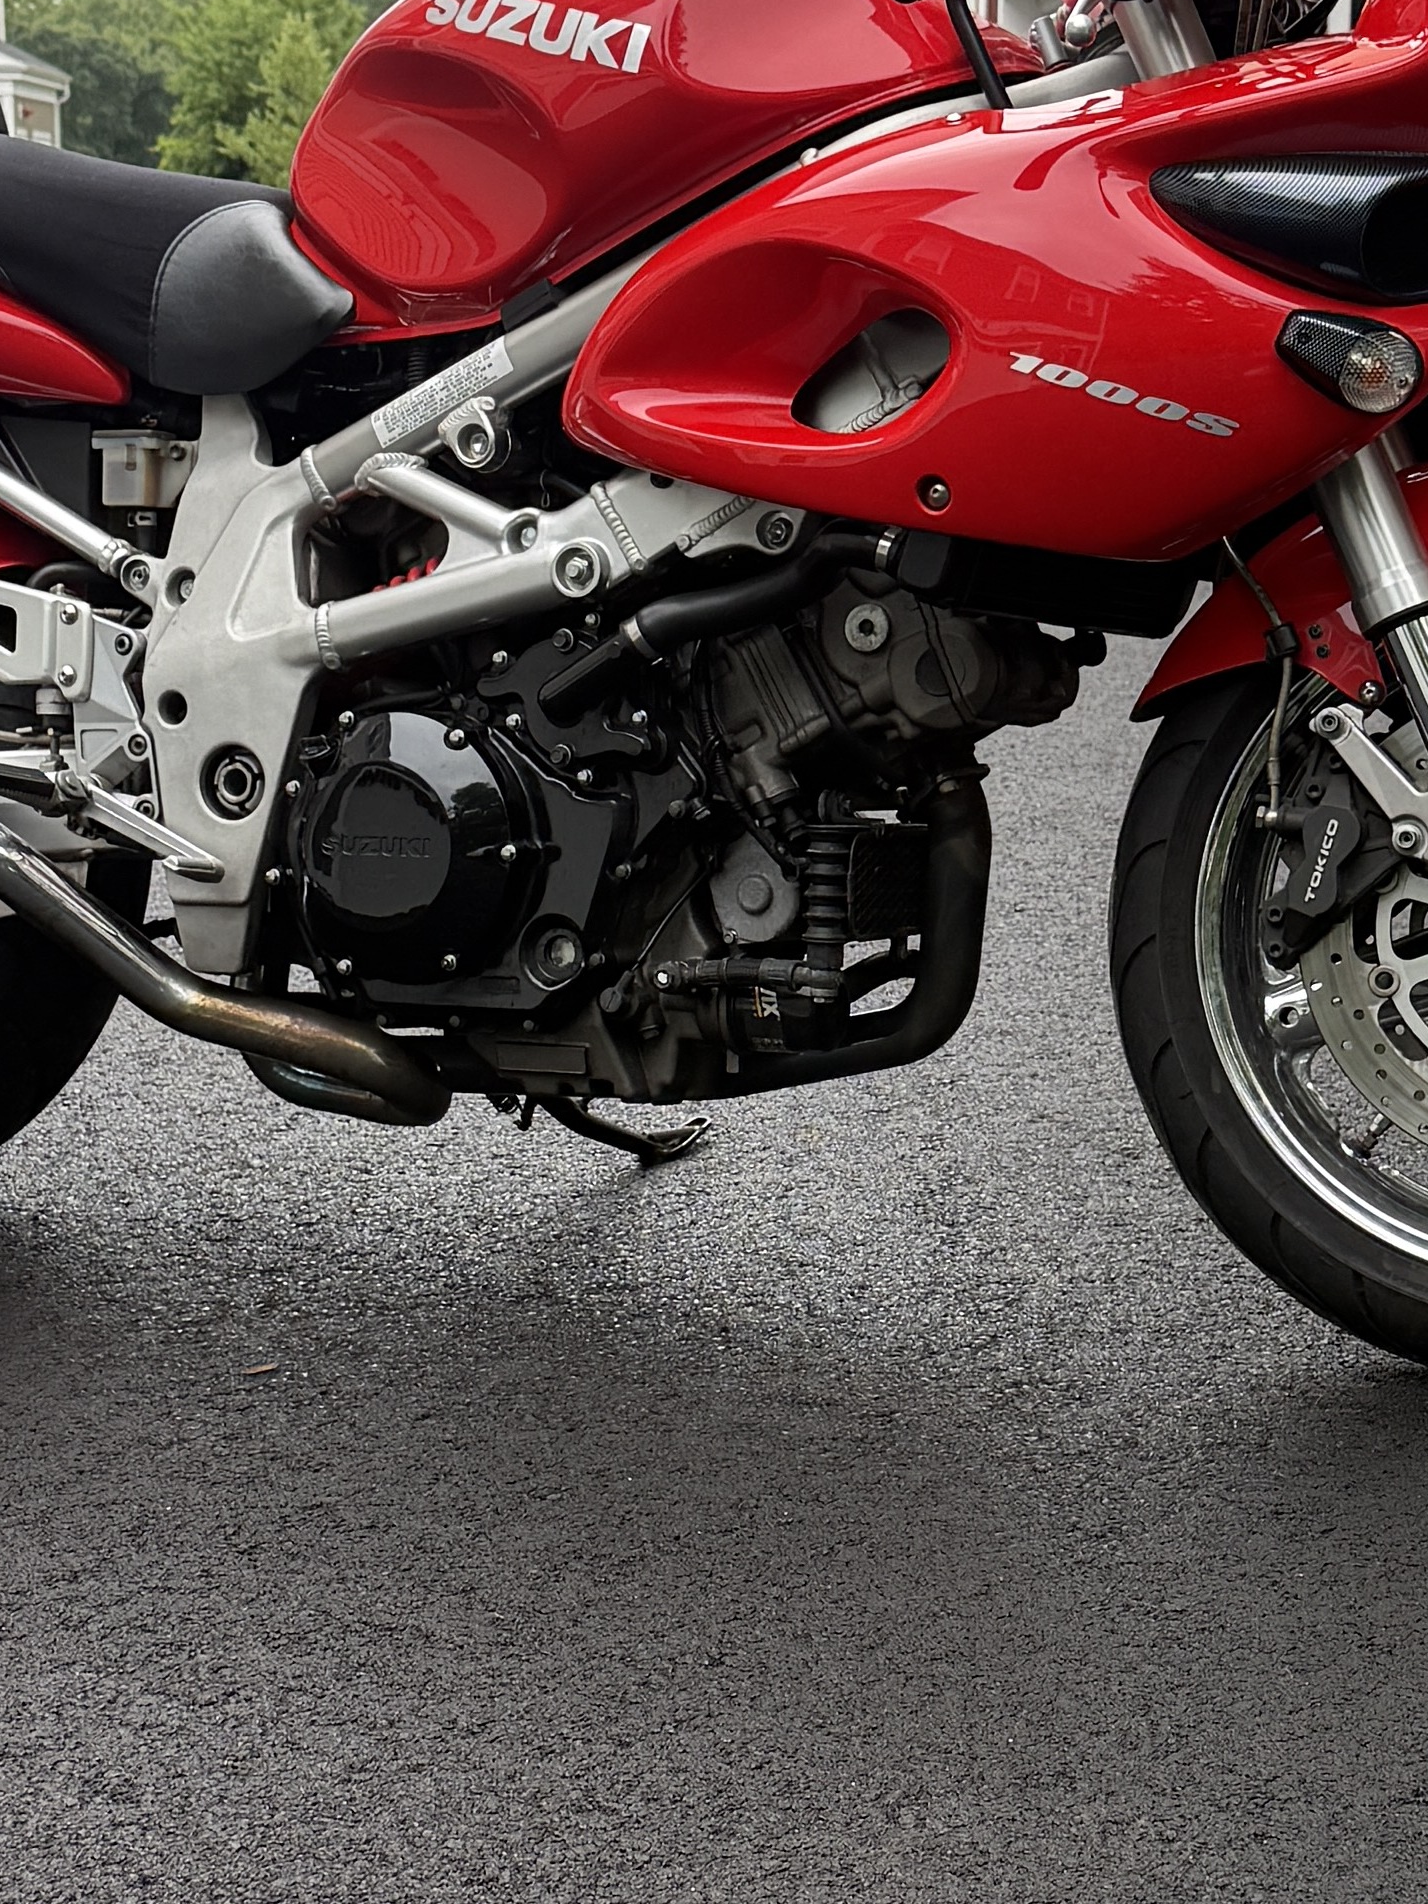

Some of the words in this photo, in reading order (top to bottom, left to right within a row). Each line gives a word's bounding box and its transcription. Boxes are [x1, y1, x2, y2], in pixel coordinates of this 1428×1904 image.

[1008, 351, 1241, 438] 1000S
[321, 833, 432, 859] SUZUKI
[1304, 818, 1339, 903] TOKICO
